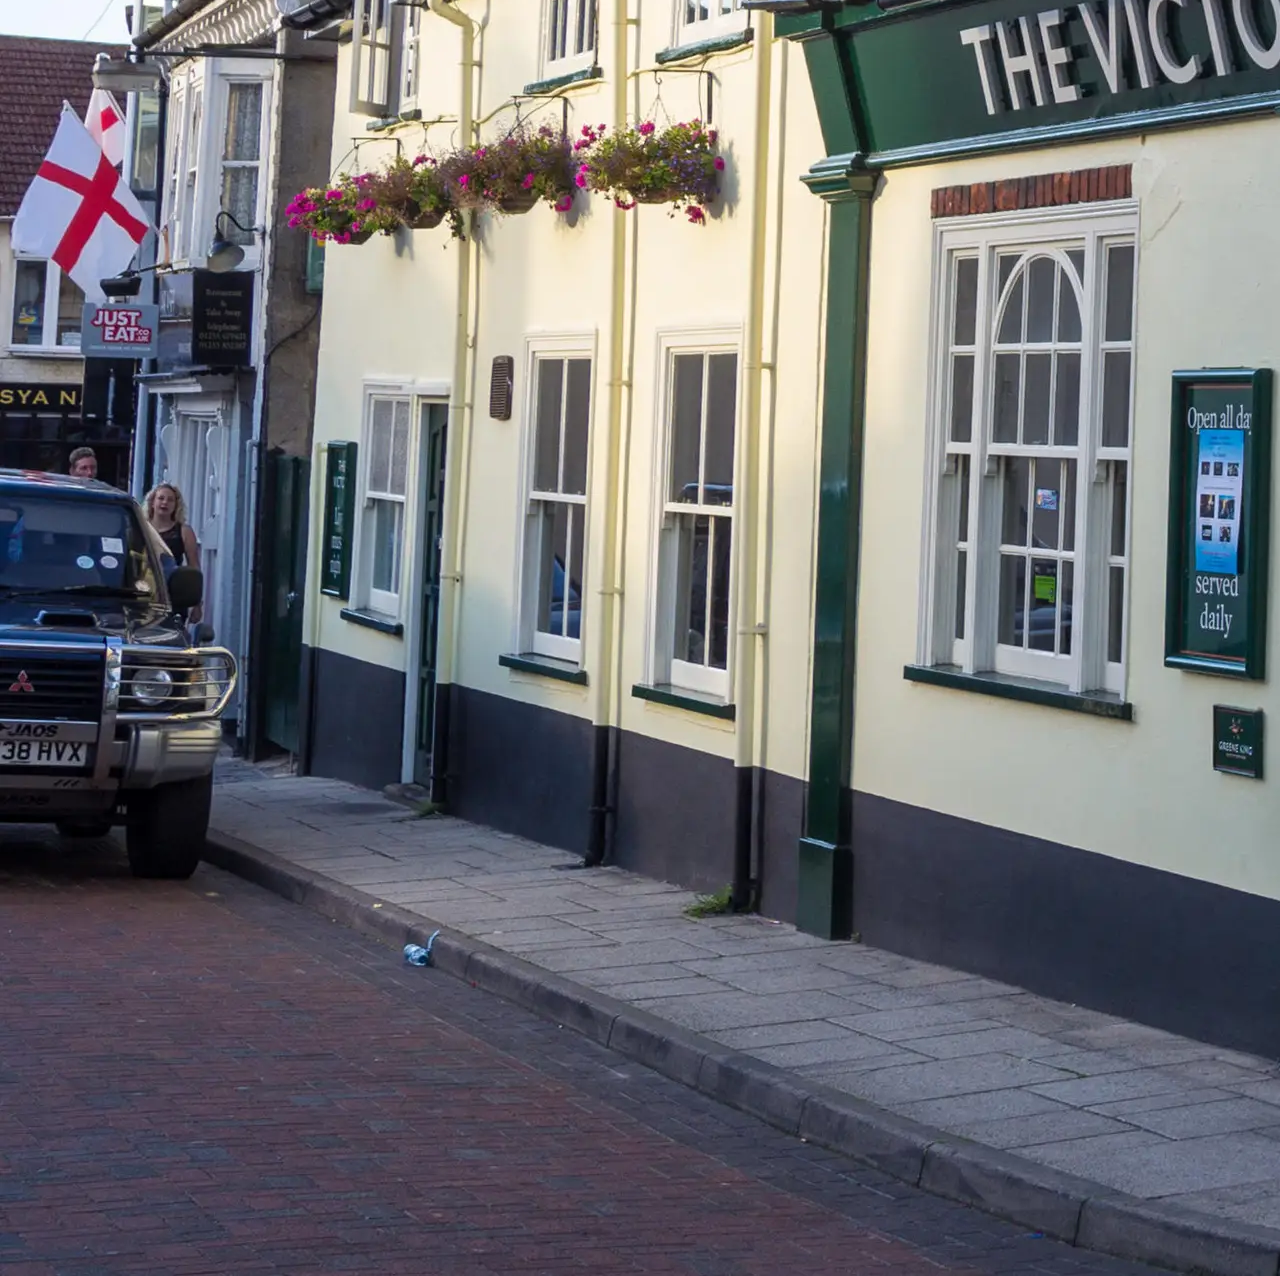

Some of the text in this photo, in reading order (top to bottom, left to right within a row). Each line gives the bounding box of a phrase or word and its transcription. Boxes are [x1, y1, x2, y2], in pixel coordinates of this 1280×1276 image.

[960, 8, 1084, 115] THE
[94, 310, 140, 326] JUST
[104, 326, 138, 341] EAT
[60, 391, 83, 405] N
[1187, 406, 1217, 435] Open
[1220, 404, 1234, 429] all
[1196, 573, 1239, 598] served
[1200, 603, 1233, 639] daily
[8, 725, 58, 738] JAOS
[2, 741, 83, 762] 38 HVX
